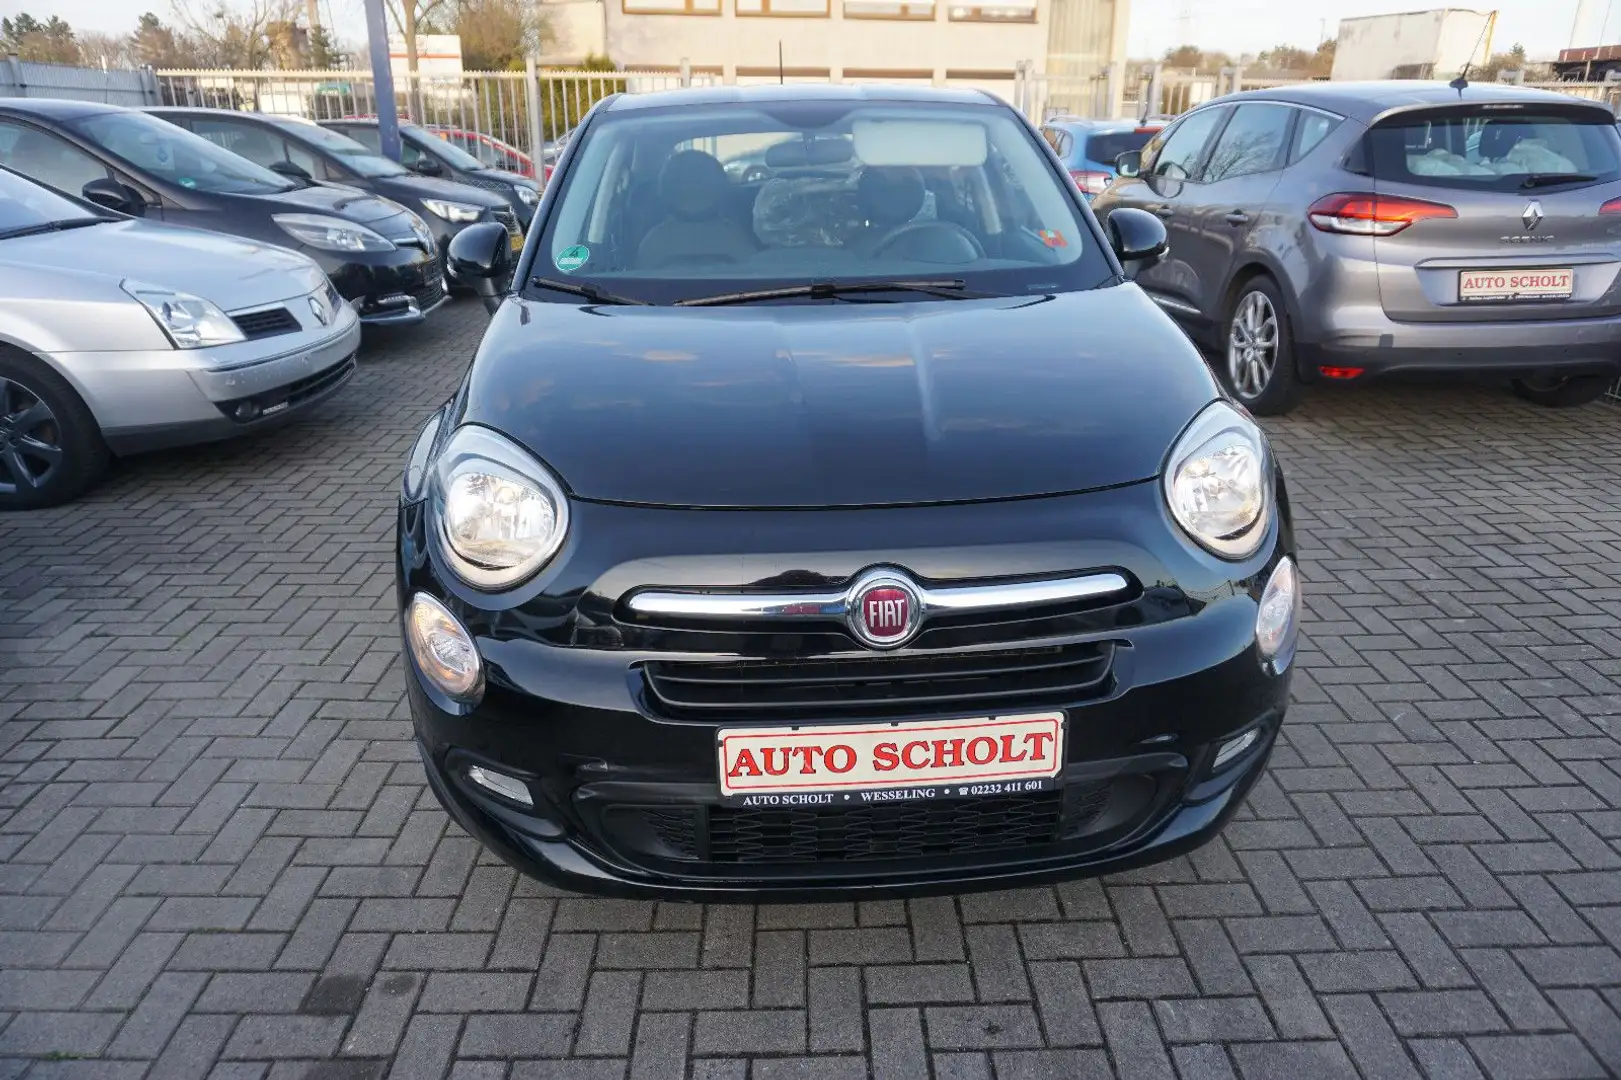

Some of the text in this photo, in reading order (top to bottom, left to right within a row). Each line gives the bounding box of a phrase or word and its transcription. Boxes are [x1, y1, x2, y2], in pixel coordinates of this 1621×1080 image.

[1463, 275, 1569, 289] AUTO SCHOLT
[869, 599, 904, 628] FIAT
[728, 732, 1053, 778] AUTO SCHOLT
[743, 780, 1043, 806] AUTO SCHOLT WESSELING 02232 411 601
